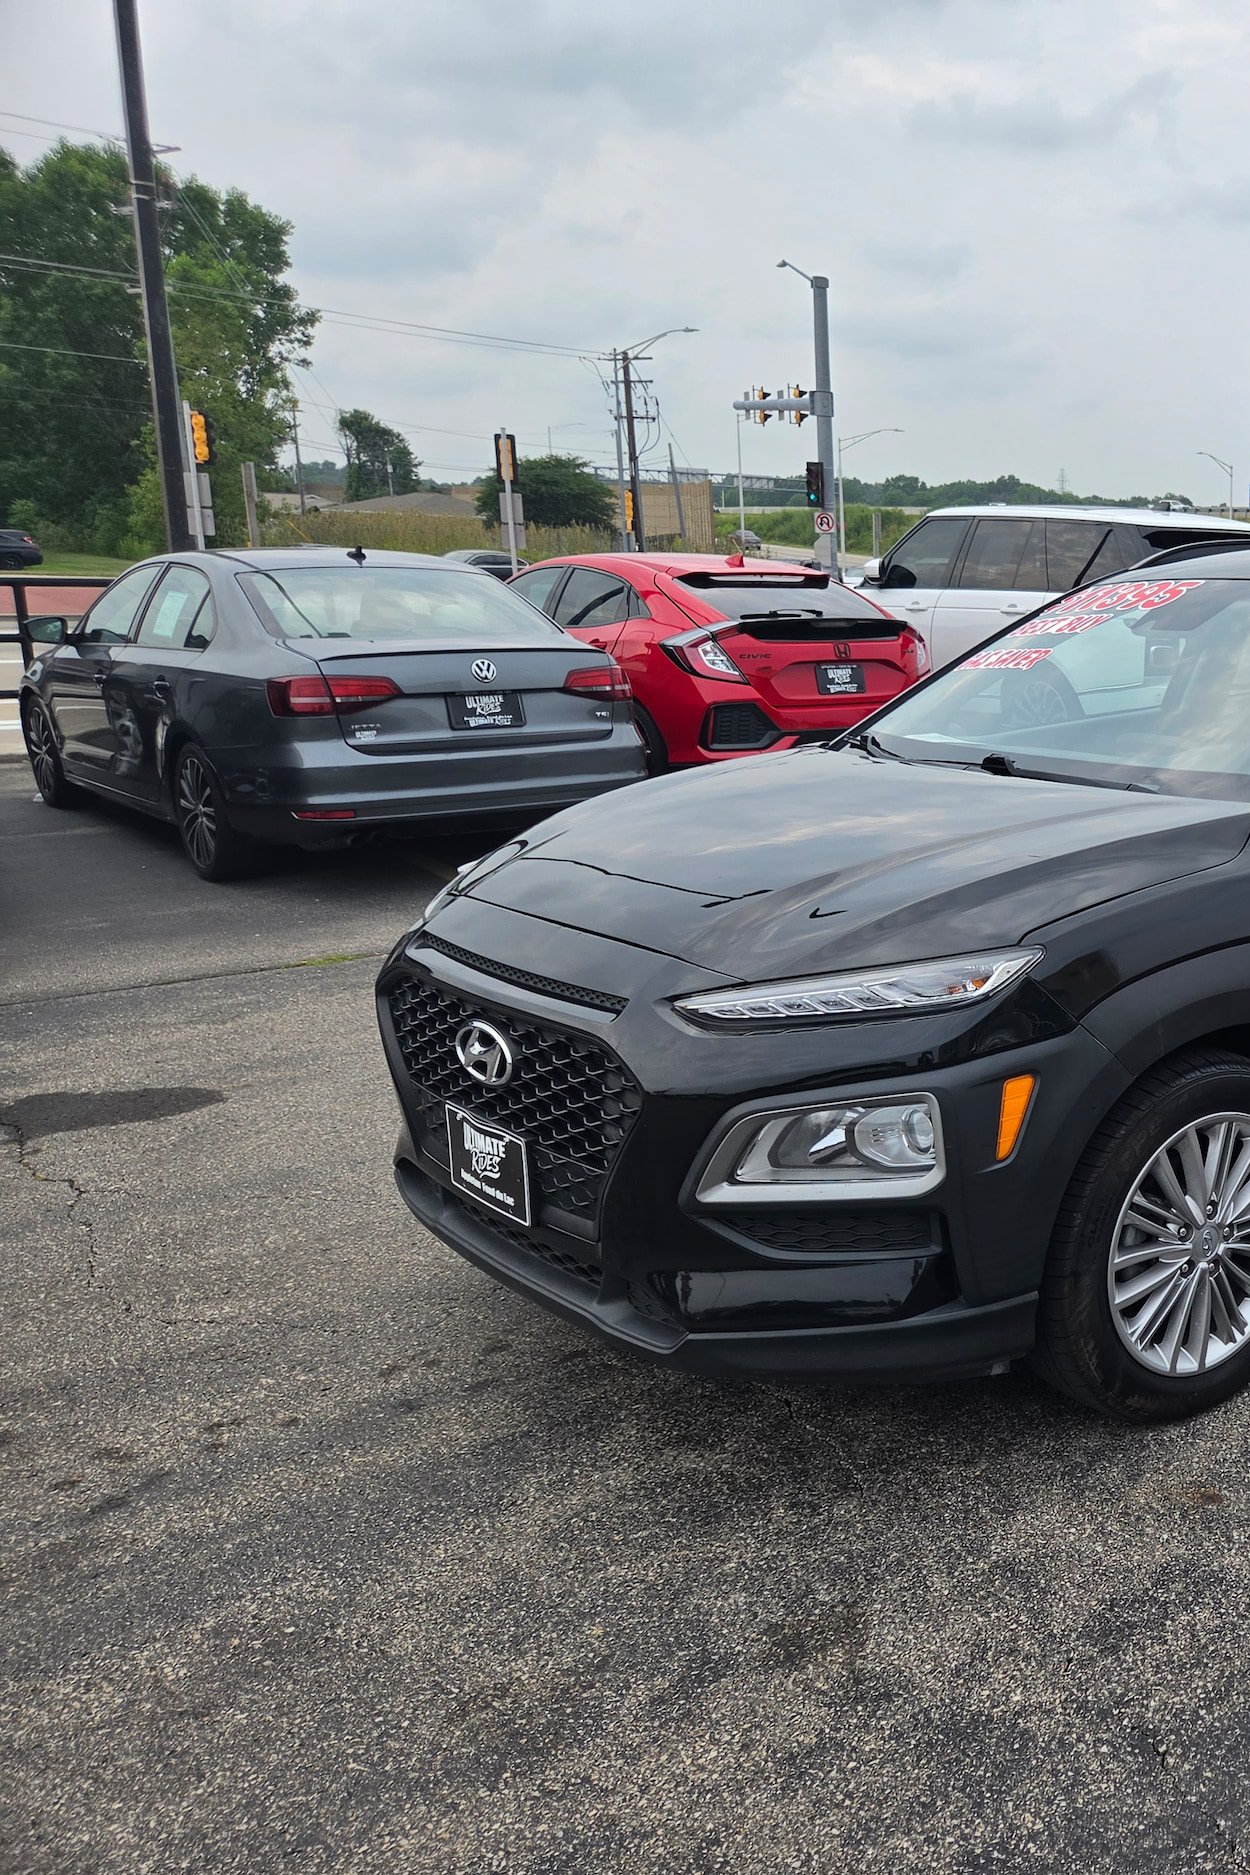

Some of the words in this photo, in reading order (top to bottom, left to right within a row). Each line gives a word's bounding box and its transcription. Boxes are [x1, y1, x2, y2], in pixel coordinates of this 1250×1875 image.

[1056, 613, 1115, 634] BUY
[974, 648, 1054, 671] SAVER
[465, 695, 504, 709] ULTIMATE
[476, 702, 502, 716] RIDES
[463, 1121, 506, 1158] ULTIMATE
[470, 1147, 502, 1176] RIDES
